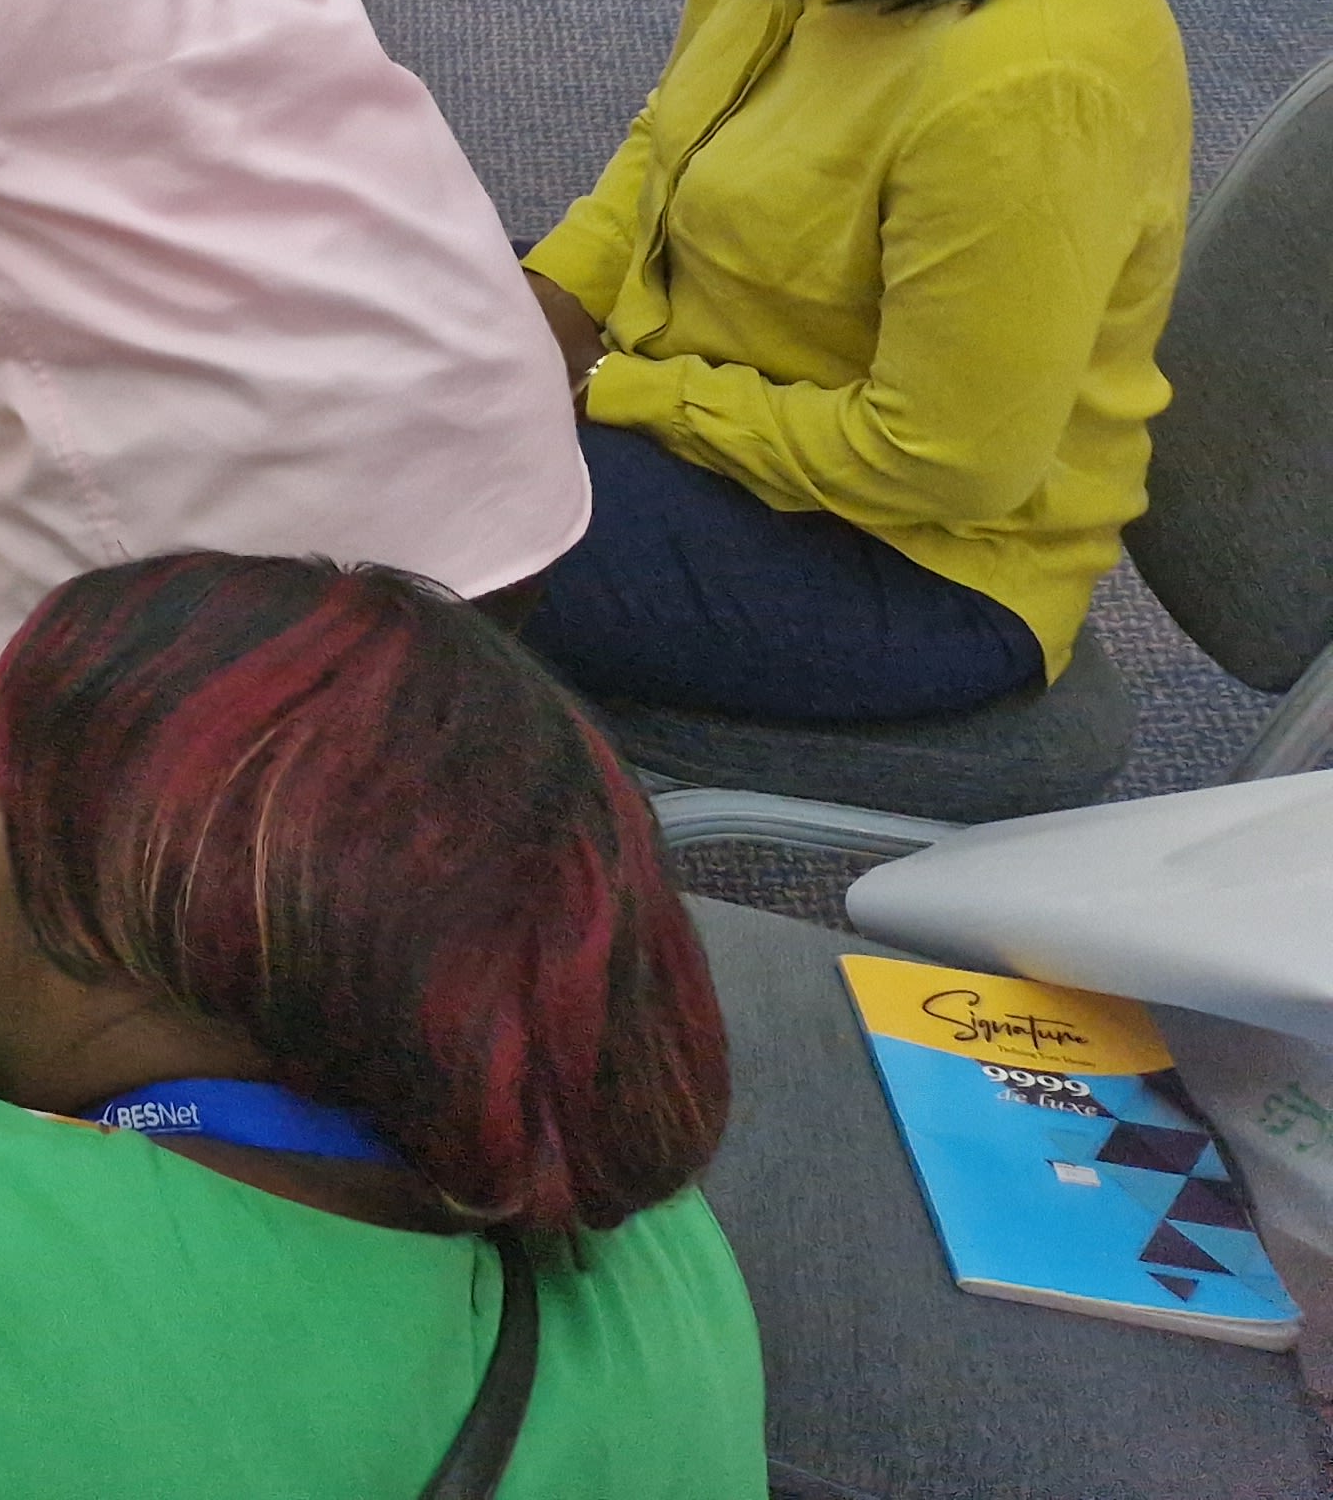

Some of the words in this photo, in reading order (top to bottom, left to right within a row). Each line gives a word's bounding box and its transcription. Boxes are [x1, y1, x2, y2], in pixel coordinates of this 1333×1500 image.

[922, 989, 1089, 1050] Signature
[983, 1065, 1091, 1097] 9999
[117, 1101, 199, 1130] BESNet
[997, 1088, 1028, 1104] de
[1039, 1093, 1098, 1116] luxe
